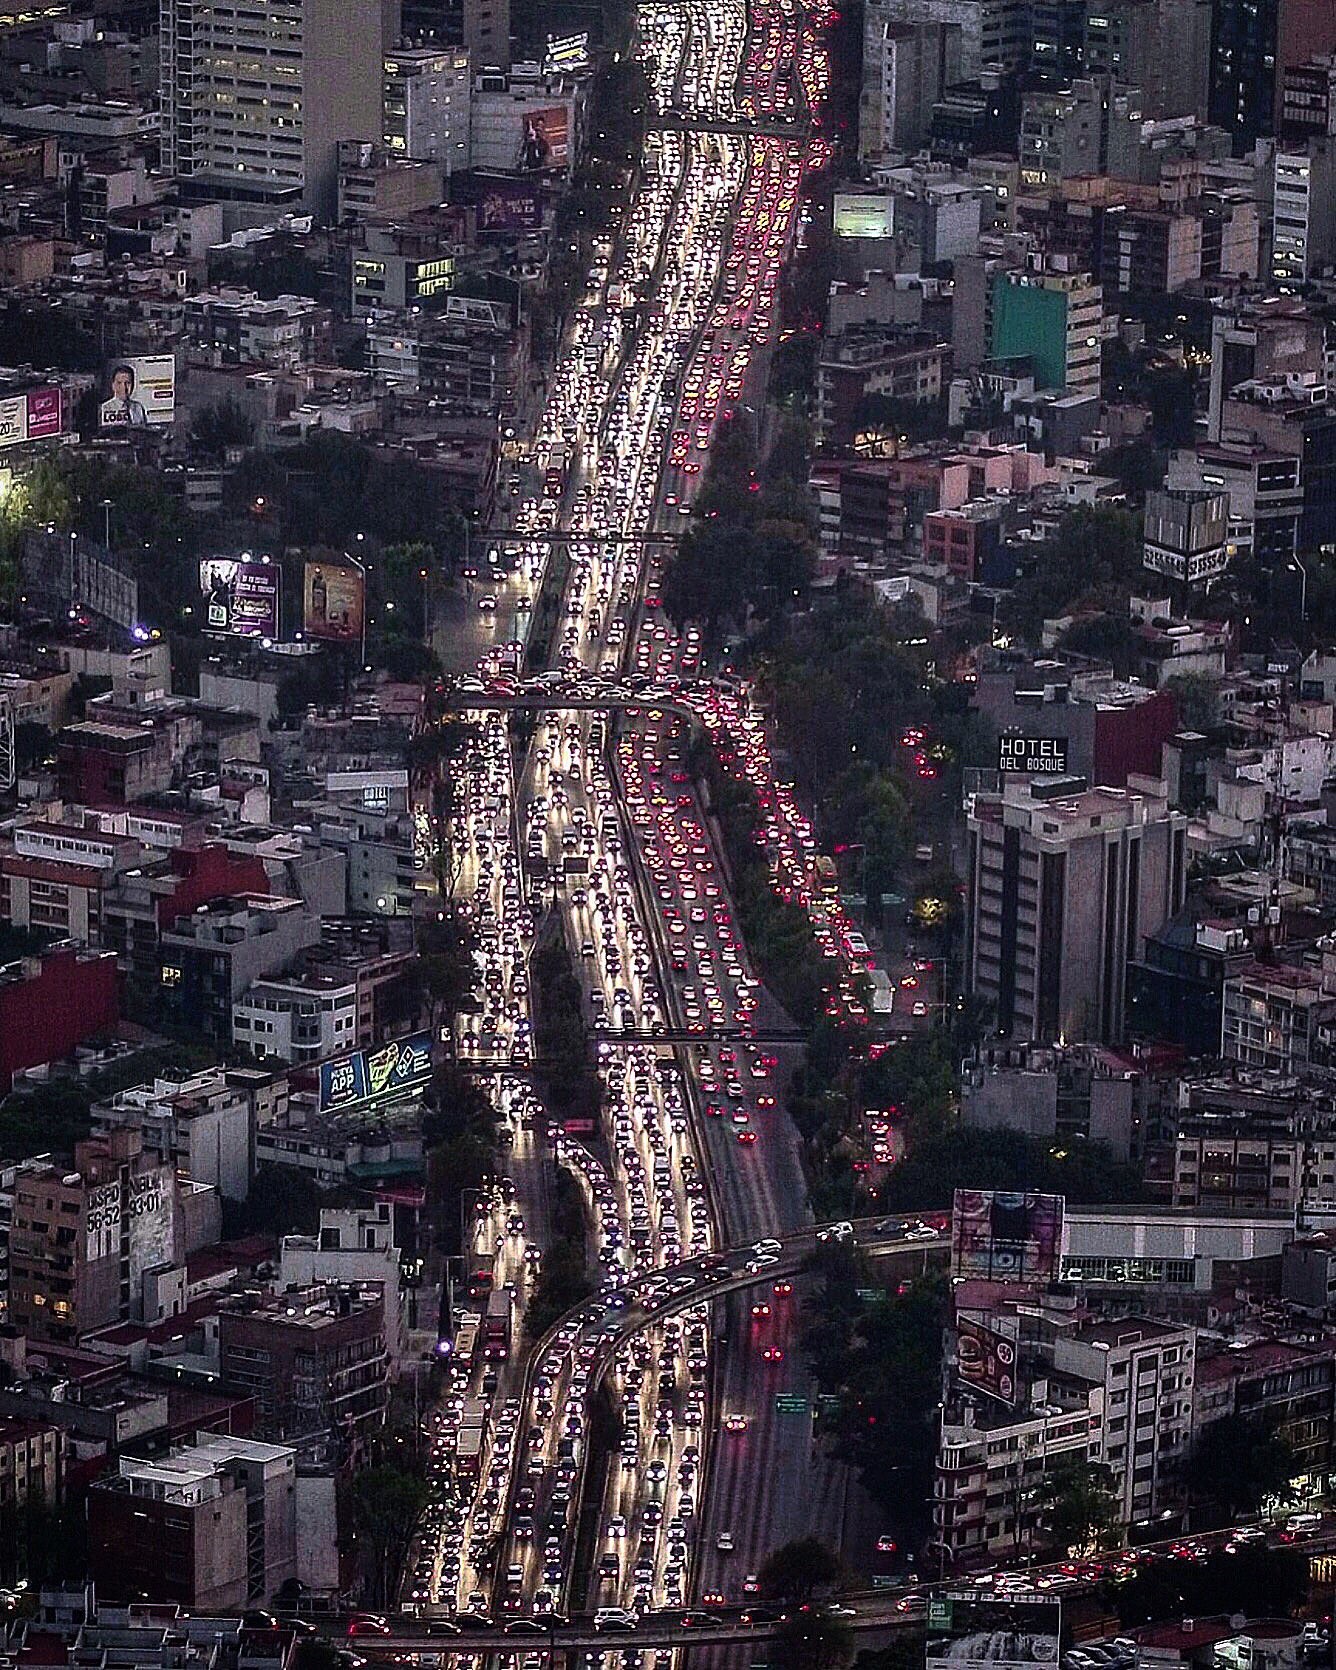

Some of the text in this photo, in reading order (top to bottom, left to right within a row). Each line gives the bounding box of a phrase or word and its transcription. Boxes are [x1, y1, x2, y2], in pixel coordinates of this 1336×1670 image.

[1001, 738, 1065, 757] HOTEL
[1000, 757, 1065, 771] DEL BOSQUE
[331, 1065, 354, 1080] NUEVA
[331, 1074, 354, 1093] APP
